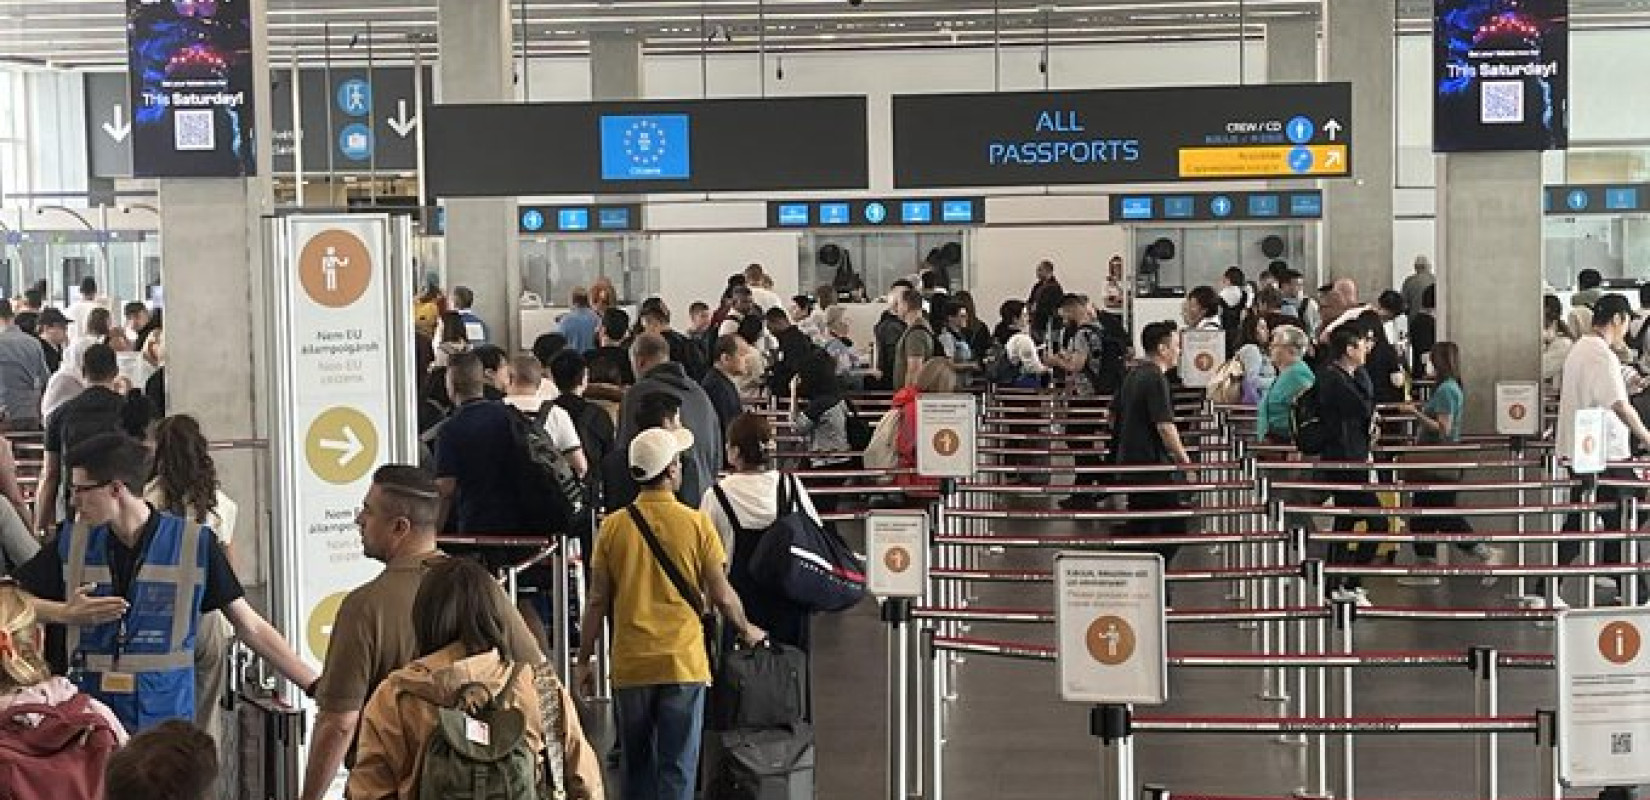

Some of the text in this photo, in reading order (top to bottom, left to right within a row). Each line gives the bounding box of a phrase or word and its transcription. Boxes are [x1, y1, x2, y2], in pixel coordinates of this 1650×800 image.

[1446, 61, 1557, 77] This Saturday!
[142, 91, 243, 106] This Saturday!
[1036, 111, 1085, 132] ALL
[989, 140, 1139, 165] PASSPORTS
